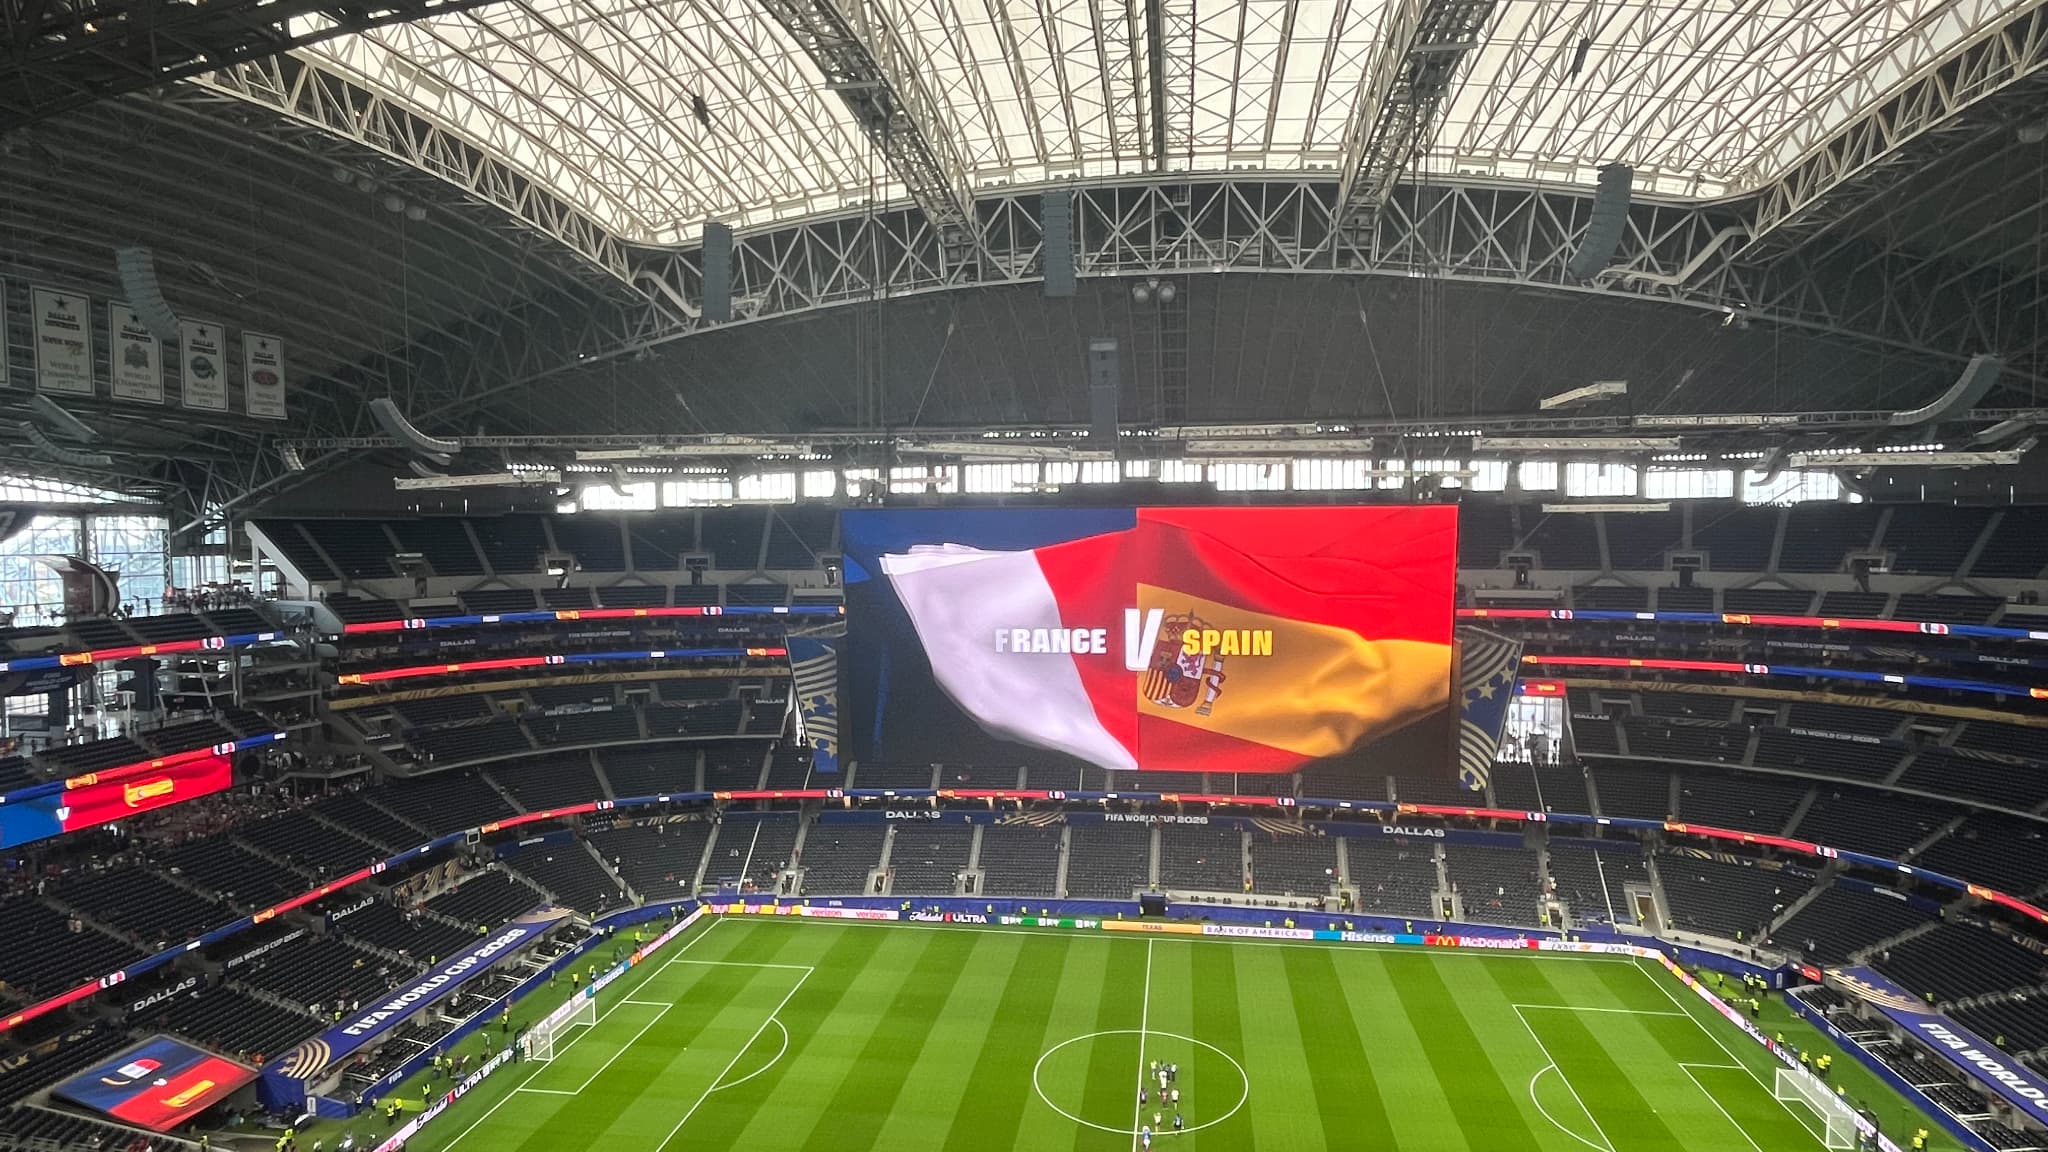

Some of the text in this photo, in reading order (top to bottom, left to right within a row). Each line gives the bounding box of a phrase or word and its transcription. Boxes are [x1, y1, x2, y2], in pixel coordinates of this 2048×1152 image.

[995, 608, 1274, 672] FRANCE V SPAIN
[1105, 813, 1123, 822] FIFA
[1177, 816, 1209, 824] 2026
[1382, 825, 1446, 838] DALLAS
[332, 896, 375, 922] DALLAS
[952, 913, 988, 925] ULTRA
[1207, 926, 1234, 935] BANK
[1237, 927, 1249, 935] OF
[1252, 928, 1299, 938] AMERICA
[1341, 931, 1395, 944] Hisense
[1459, 935, 1529, 950] McDonald's
[342, 928, 528, 1036] FIFA WORLD CUP 2026
[133, 976, 197, 1012] DALLAS
[1918, 1023, 2046, 1099] FIFA WORLD
[454, 1070, 483, 1099] ULTRA
